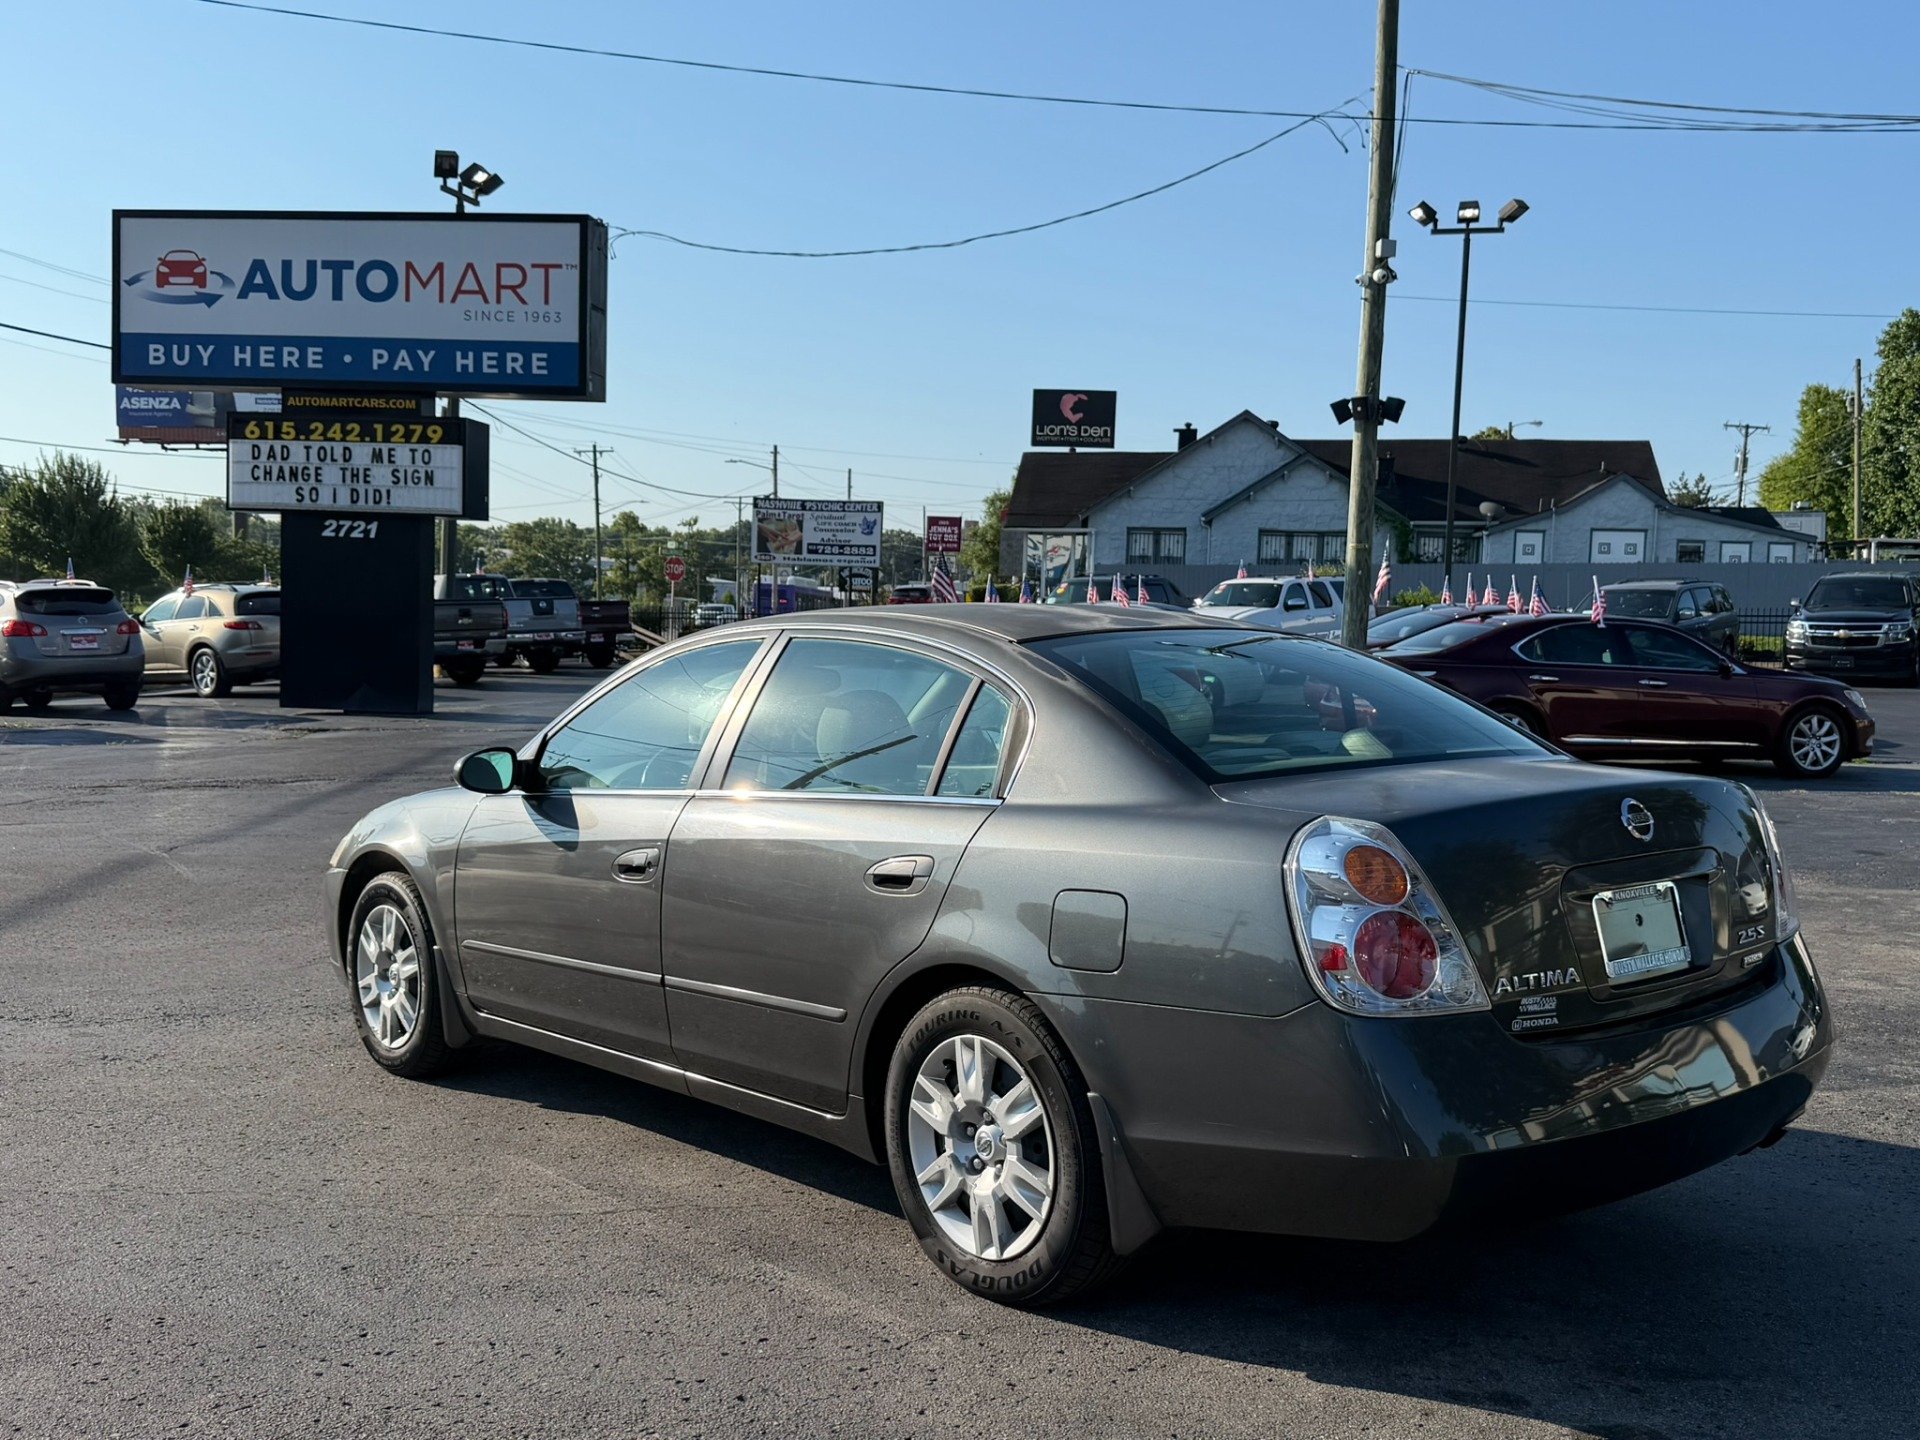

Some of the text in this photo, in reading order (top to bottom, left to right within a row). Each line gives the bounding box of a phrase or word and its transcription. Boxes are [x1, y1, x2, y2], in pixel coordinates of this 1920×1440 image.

[236, 258, 564, 306] AUTOMART
[463, 310, 563, 324] SINCE 1963
[148, 344, 549, 375] BUY HERE PAY HERE
[119, 397, 181, 410] ASENZA
[287, 396, 417, 409] AUTOMARTCARS.COM
[244, 421, 444, 444] 615.242.1279
[252, 445, 432, 466] DAD TOLD ME TO
[251, 465, 435, 486] CHANGE THE SIGN
[295, 487, 393, 505] SO I DID!
[804, 501, 844, 511] PSYCHIC
[844, 502, 879, 512] CENTER
[809, 513, 847, 521] Spiritual
[321, 519, 379, 539] 2721
[928, 526, 959, 534] JENNA'S
[928, 533, 942, 541] TOY
[816, 546, 875, 556] 726-2882
[782, 556, 877, 566] Hablamos español
[665, 564, 684, 574] STOP
[1614, 886, 1656, 901] KNOXVILLE
[1494, 967, 1581, 995] ALTIMA
[1523, 1017, 1559, 1028] HONDA
[907, 1009, 1025, 1054] TOURING A/S
[933, 1250, 1044, 1292] DOUGLAS
